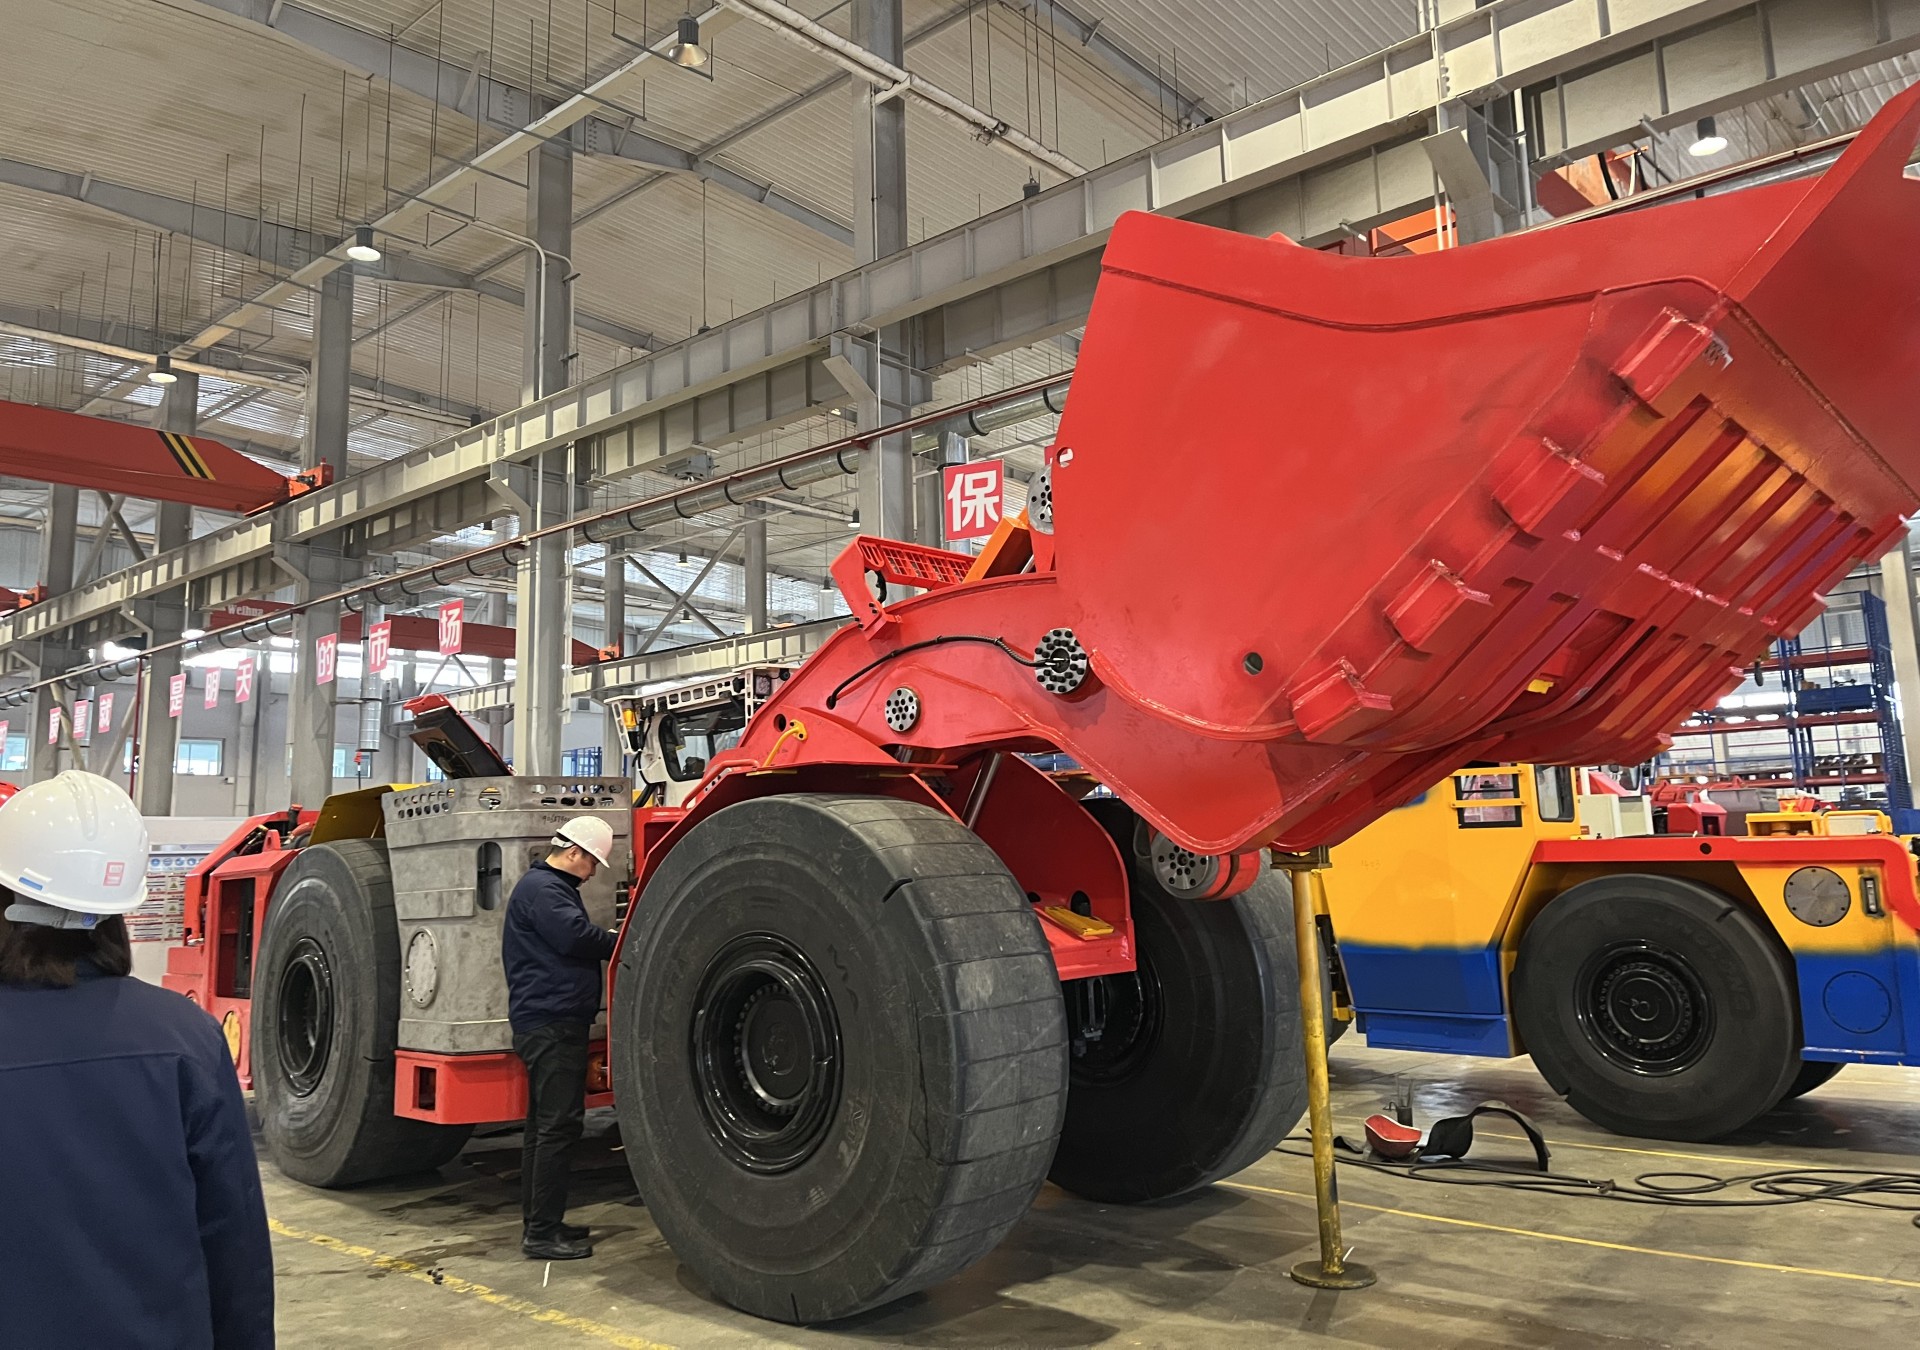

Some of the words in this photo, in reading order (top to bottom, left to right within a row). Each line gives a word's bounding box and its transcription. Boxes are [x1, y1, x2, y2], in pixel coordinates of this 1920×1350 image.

[948, 470, 1000, 532] 保
[227, 604, 264, 617] Weihua
[440, 608, 461, 648] 场
[317, 643, 335, 679] 的
[370, 628, 389, 668] 市
[170, 679, 184, 712] 是
[205, 673, 219, 704] 明
[236, 664, 252, 697] 天
[74, 706, 87, 732] 量
